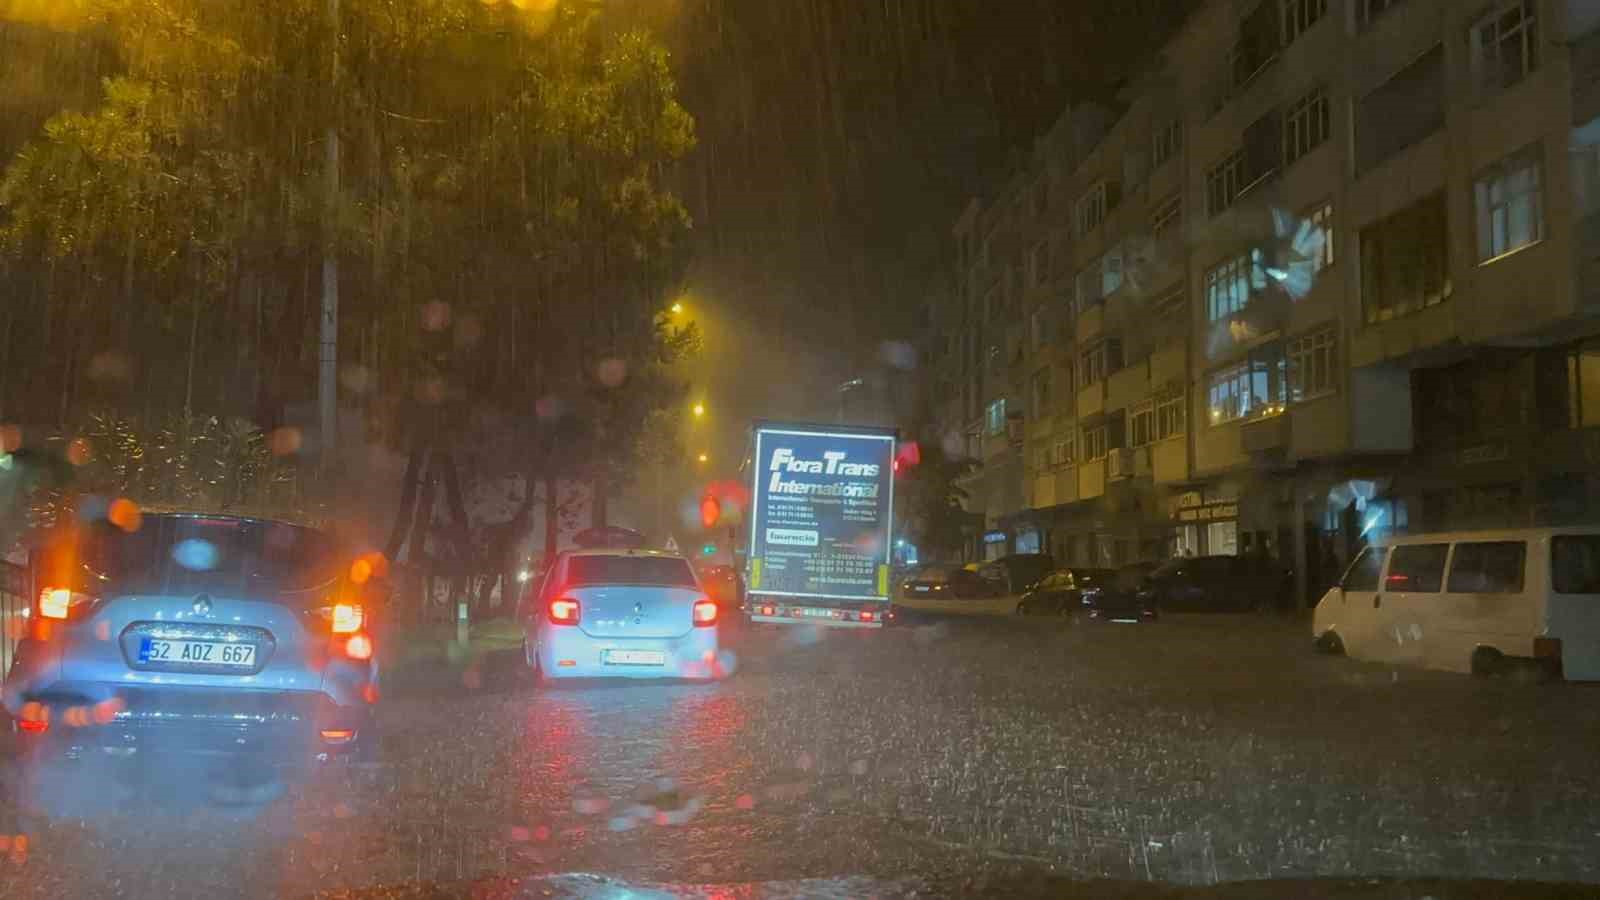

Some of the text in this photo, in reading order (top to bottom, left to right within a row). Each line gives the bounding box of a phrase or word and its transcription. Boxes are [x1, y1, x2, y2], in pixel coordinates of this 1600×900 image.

[823, 451, 880, 477] Trans
[768, 472, 879, 497] International
[150, 643, 171, 660] 52
[181, 644, 213, 661] ADZ
[222, 646, 254, 663] 667
